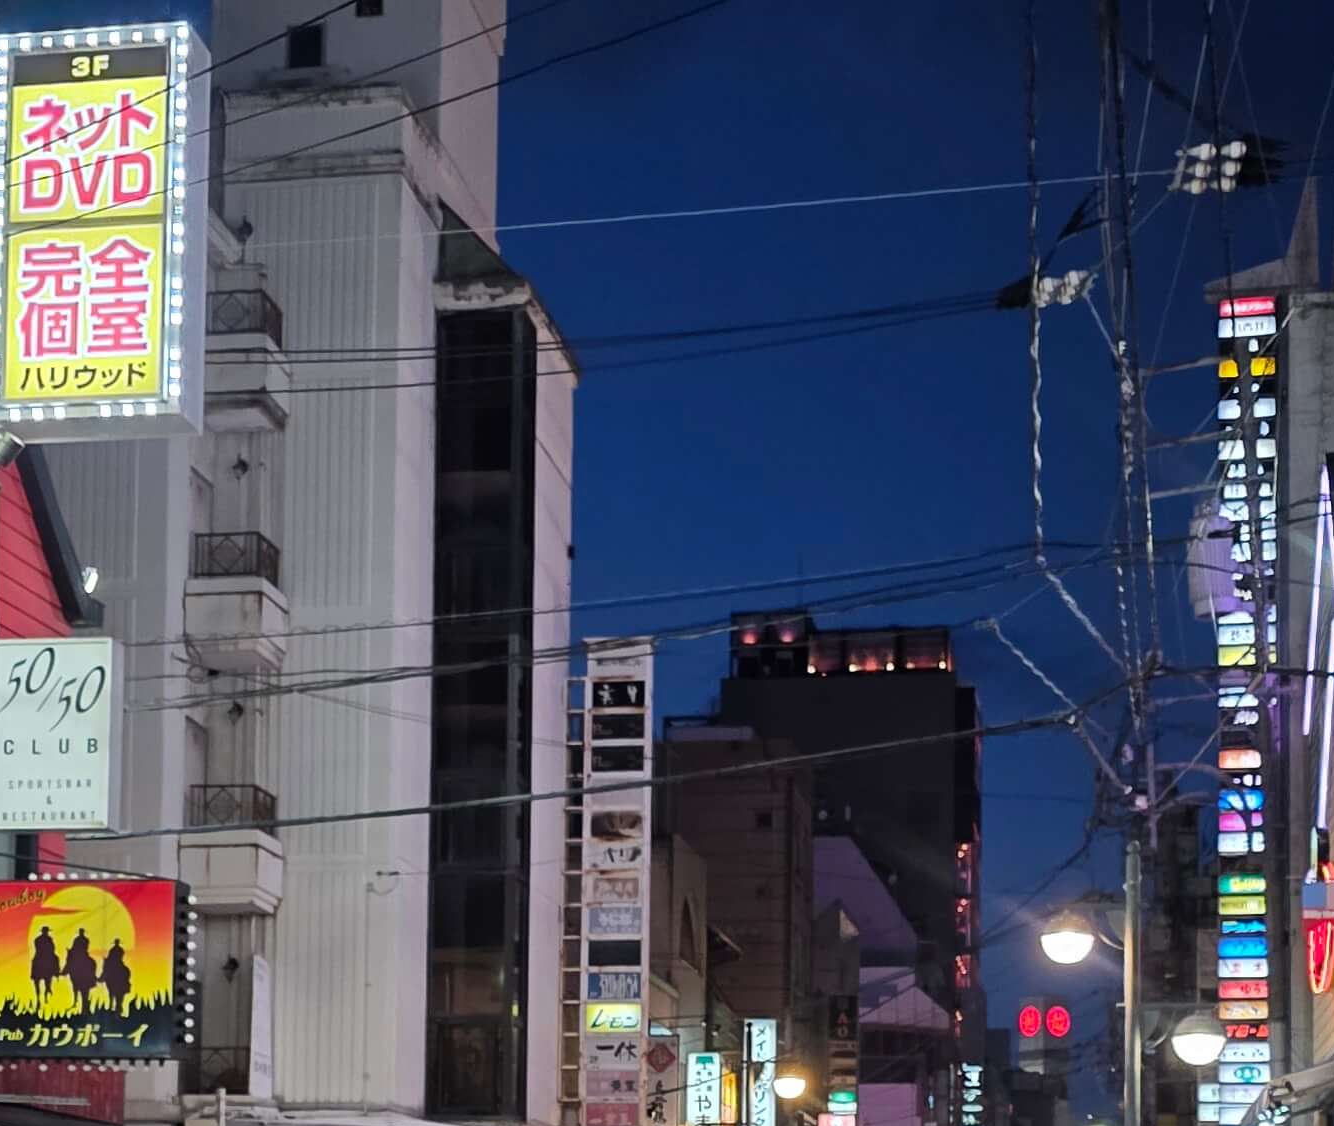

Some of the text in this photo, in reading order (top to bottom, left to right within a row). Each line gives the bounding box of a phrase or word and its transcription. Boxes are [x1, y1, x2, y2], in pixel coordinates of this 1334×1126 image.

[70, 55, 111, 78] 3F
[22, 92, 155, 152] ネット
[22, 157, 155, 213] DVD
[21, 240, 153, 301] 完全
[20, 303, 150, 359] 個室
[20, 361, 147, 392] ハリウッド
[3, 738, 99, 756] CLUB
[8, 778, 93, 790] SPORTSBAR
[2, 810, 97, 822] RESTAURANT
[591, 1009, 639, 1030] レモン
[26, 1023, 150, 1048] カウボーイ
